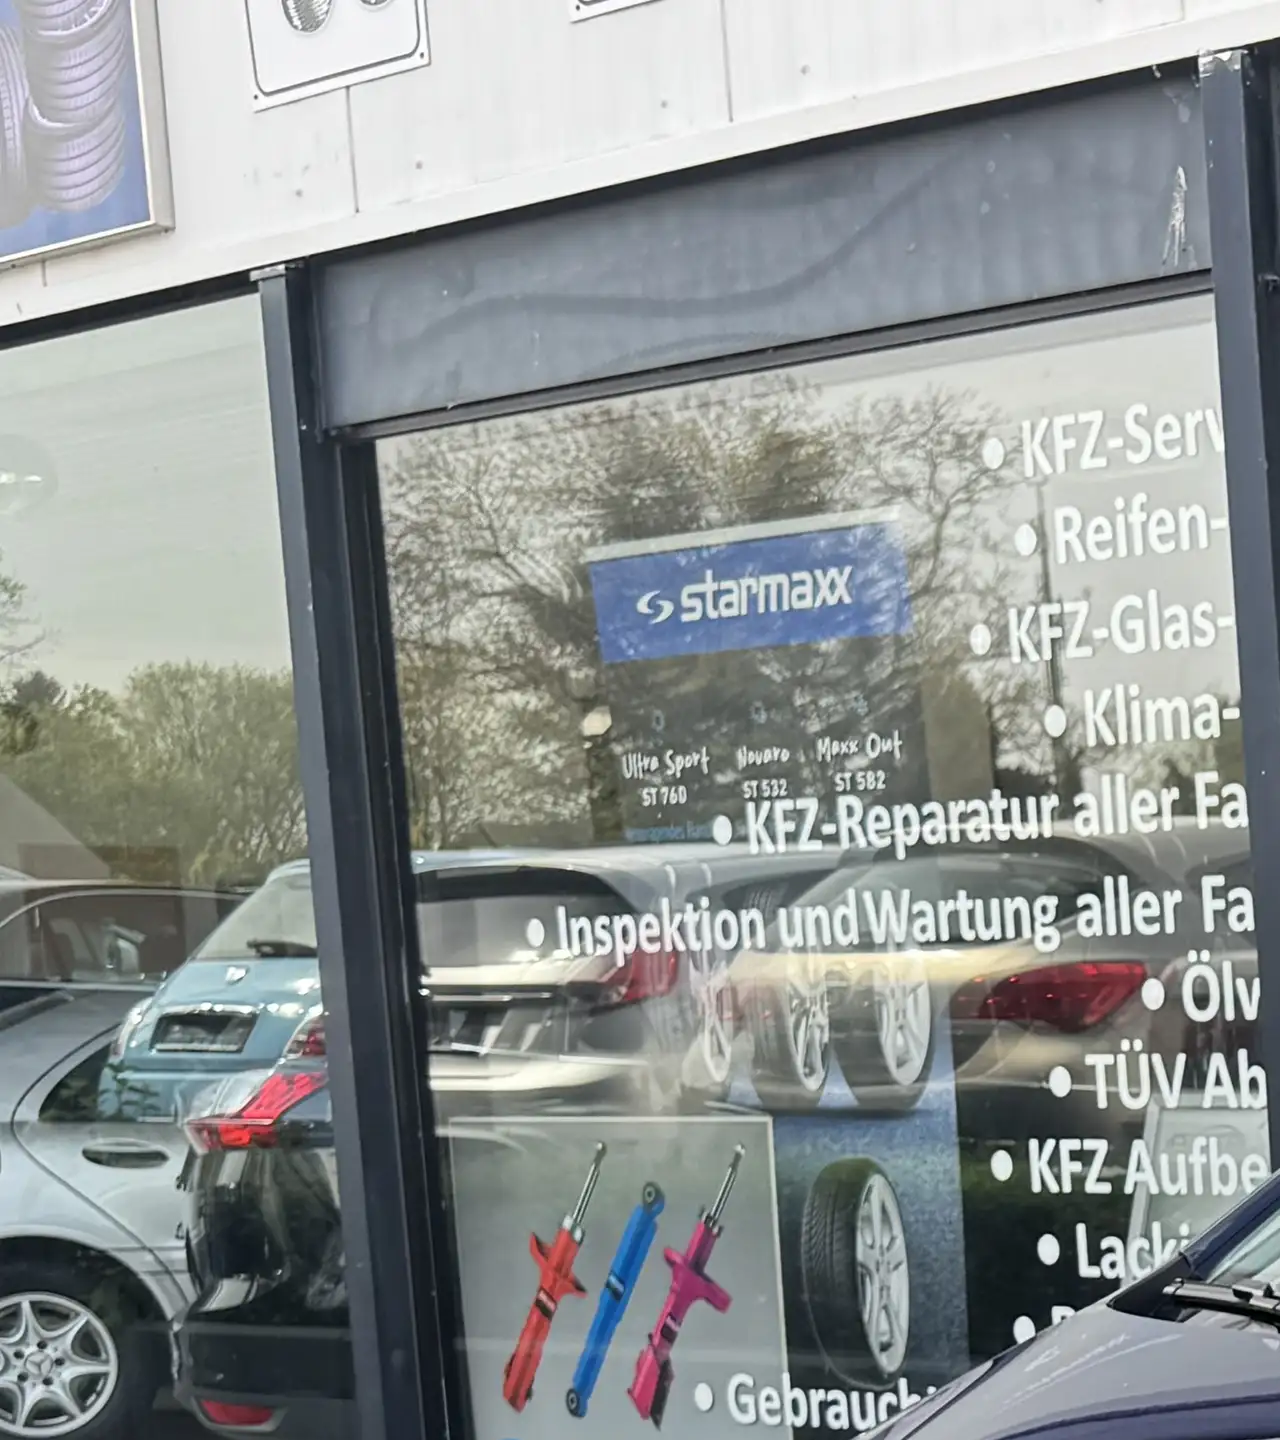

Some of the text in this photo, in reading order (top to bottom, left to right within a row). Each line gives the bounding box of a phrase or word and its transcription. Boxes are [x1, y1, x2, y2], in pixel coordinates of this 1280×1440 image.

[1055, 493, 1228, 564] Reifen-
[681, 566, 853, 622] starmaxx
[1008, 589, 1235, 664] KFZ-Glas-
[1085, 683, 1240, 748] Klima-
[622, 747, 710, 779] Ultra Sport
[865, 730, 902, 760] Out
[642, 788, 659, 806] ST
[743, 778, 788, 798] ST 532
[835, 770, 886, 792] ST 582
[746, 788, 1060, 860] KFZ-Reparatur
[1073, 774, 1179, 836] aller
[556, 896, 767, 968] Inspektion
[778, 888, 859, 948] und
[864, 887, 1060, 952] Wartung
[1076, 875, 1182, 937] aller
[1085, 1039, 1268, 1110] TÜV Ab
[1027, 1137, 1271, 1197] KFZ Aufbe
[727, 1373, 937, 1430] Gebrauch
